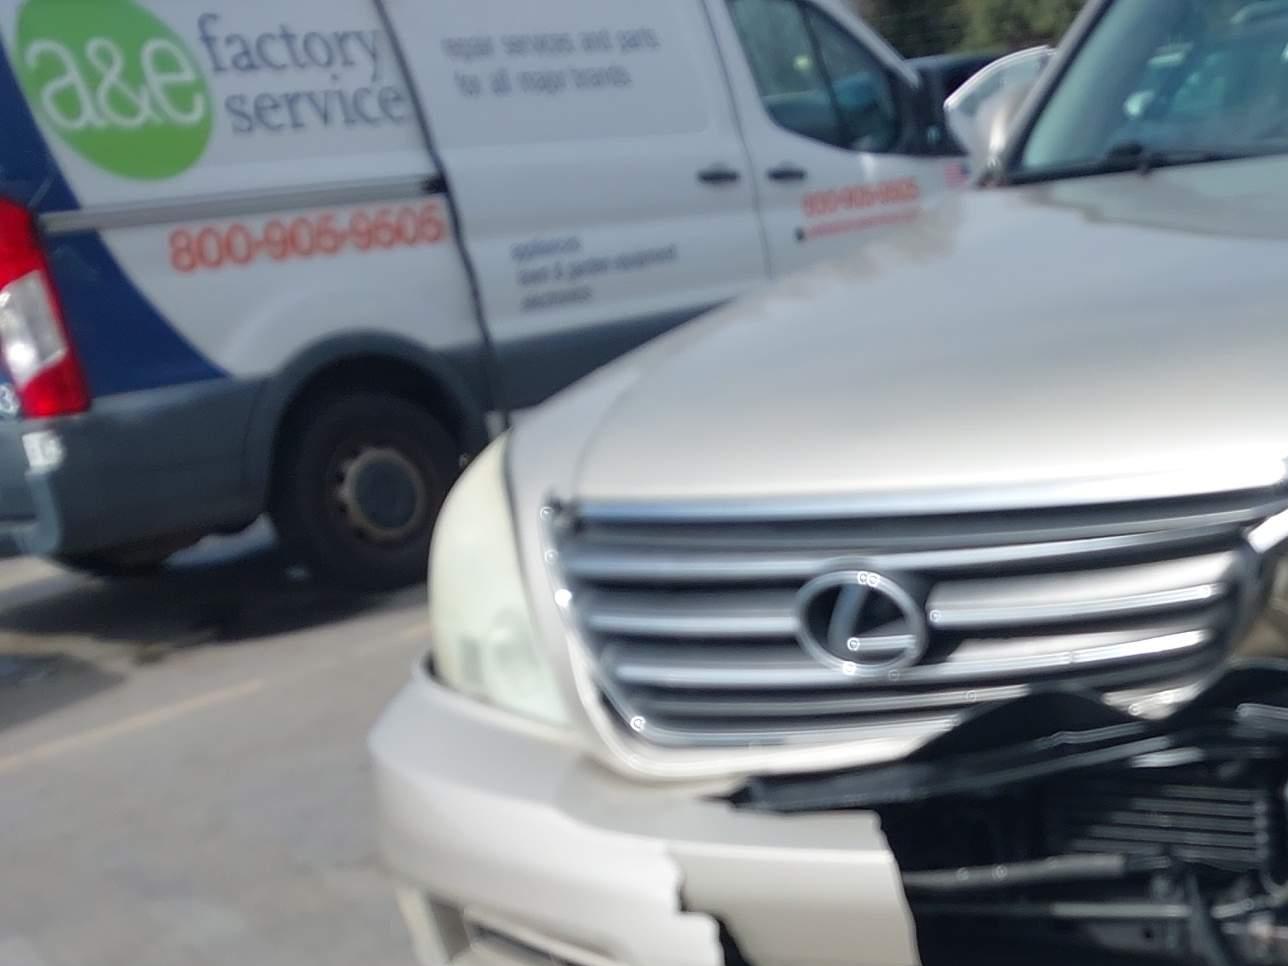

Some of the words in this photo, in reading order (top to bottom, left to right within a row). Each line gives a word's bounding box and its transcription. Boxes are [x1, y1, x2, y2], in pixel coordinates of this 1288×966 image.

[25, 36, 203, 128] a&e
[197, 13, 384, 82] factory
[224, 73, 408, 134] service
